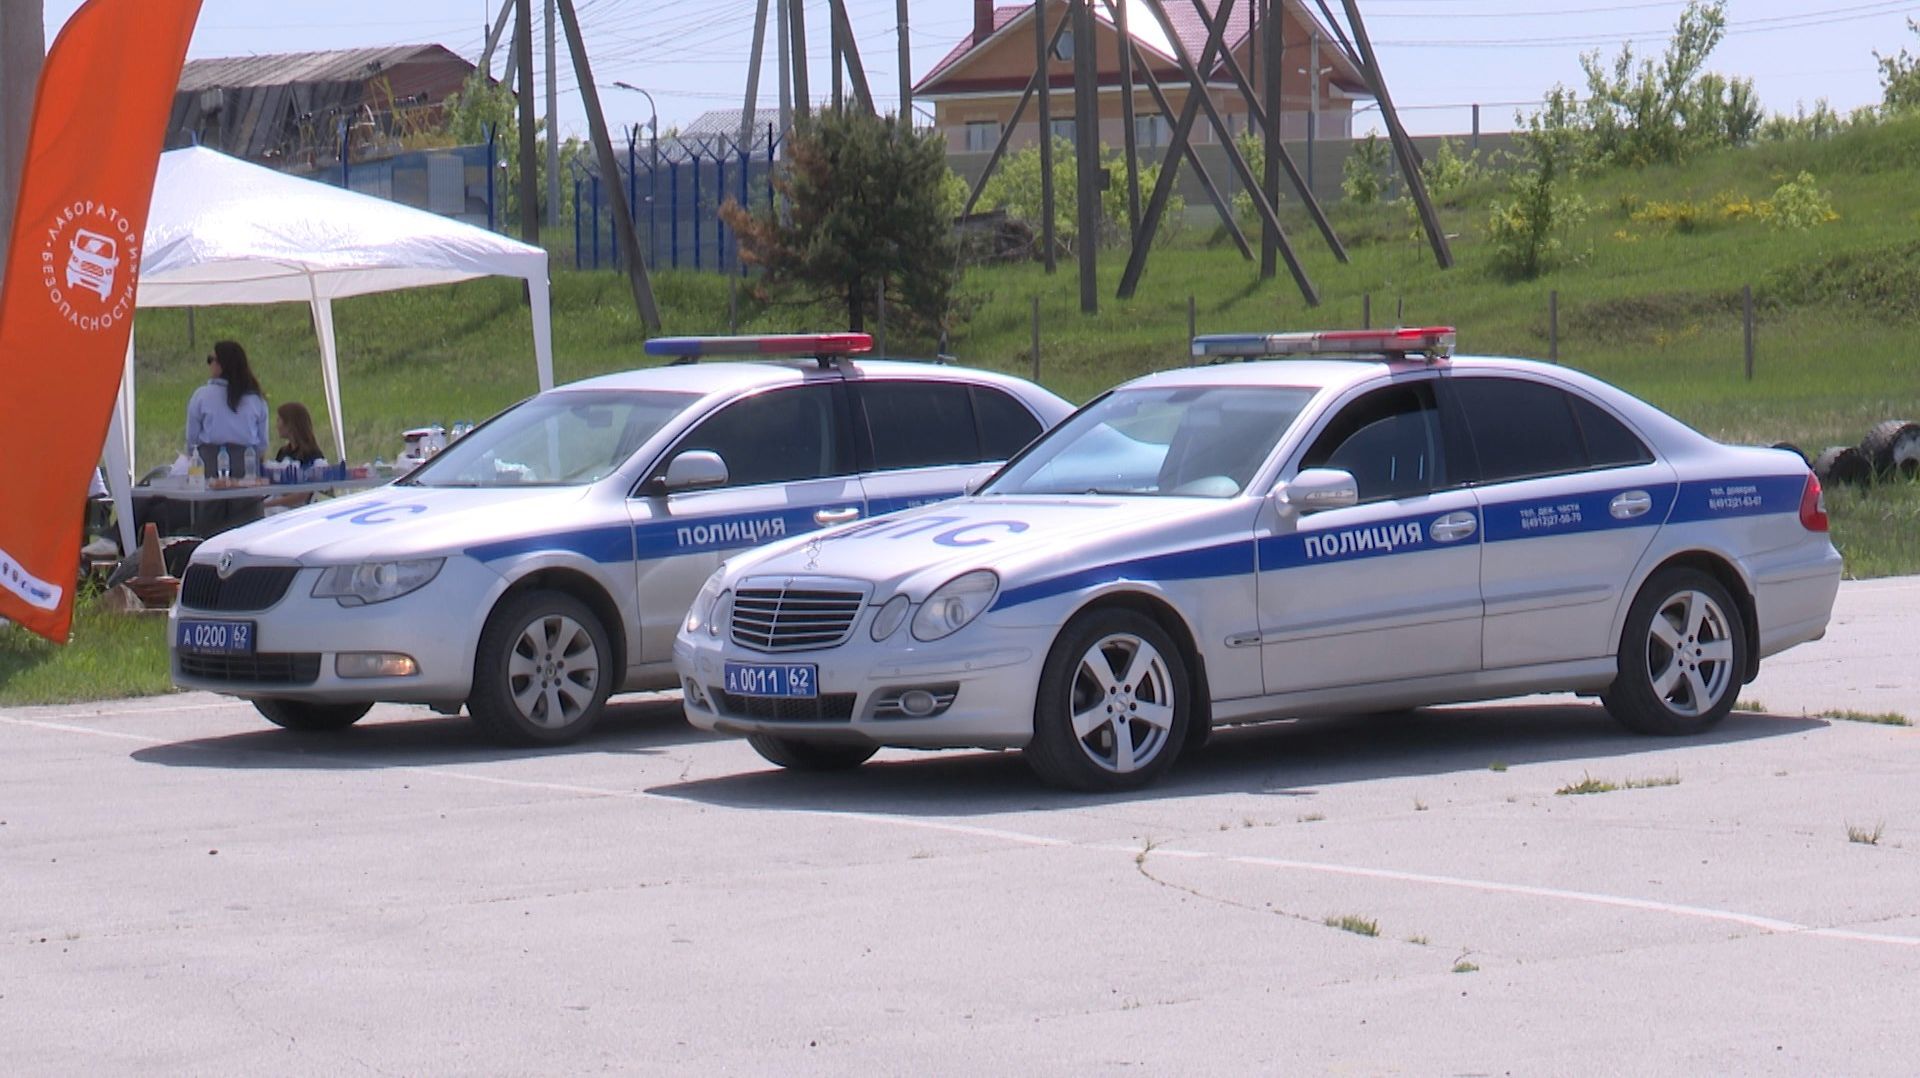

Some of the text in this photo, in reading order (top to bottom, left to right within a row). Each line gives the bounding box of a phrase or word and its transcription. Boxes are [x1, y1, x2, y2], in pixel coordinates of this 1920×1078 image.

[49, 201, 138, 273] ЛАБОРАТОРИЯ
[41, 251, 135, 331] БЕЗОПАСНОСТИ
[677, 517, 786, 547] ПОЛИЦИЯ
[1304, 522, 1423, 558] ПОЛИЦИЯ
[195, 625, 227, 647] 0200
[234, 626, 248, 641] 62
[741, 668, 778, 693] 0011
[789, 668, 809, 687] 62
